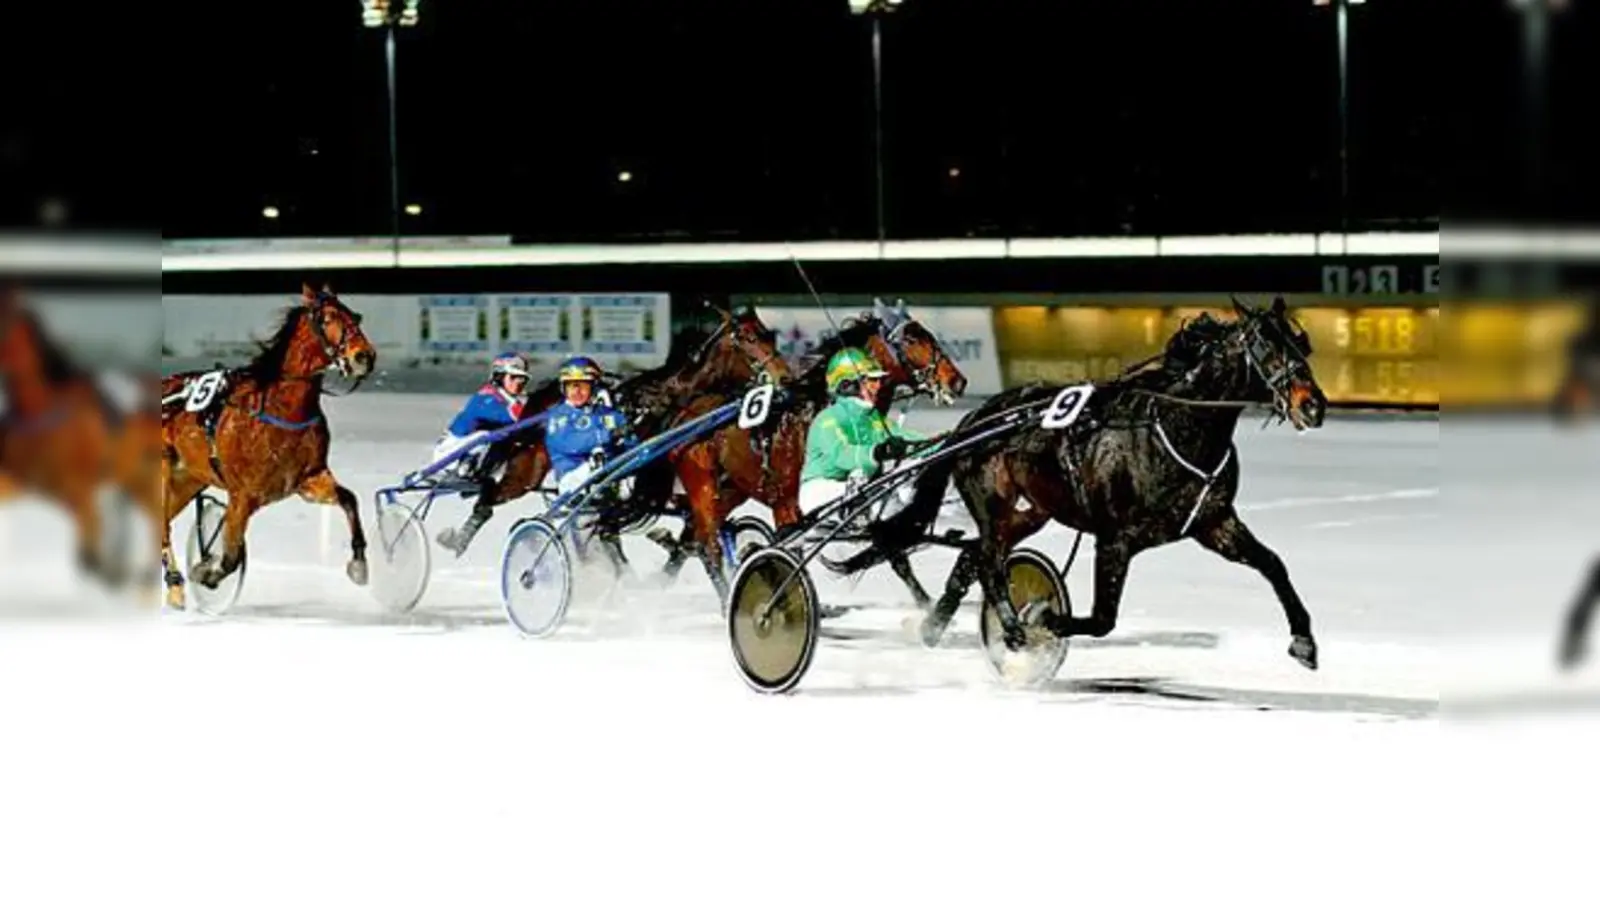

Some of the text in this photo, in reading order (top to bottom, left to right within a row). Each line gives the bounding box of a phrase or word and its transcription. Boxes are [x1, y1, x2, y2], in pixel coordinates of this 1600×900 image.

[193, 378, 216, 404] 5
[747, 390, 765, 420] 6
[1052, 390, 1082, 421] 9
